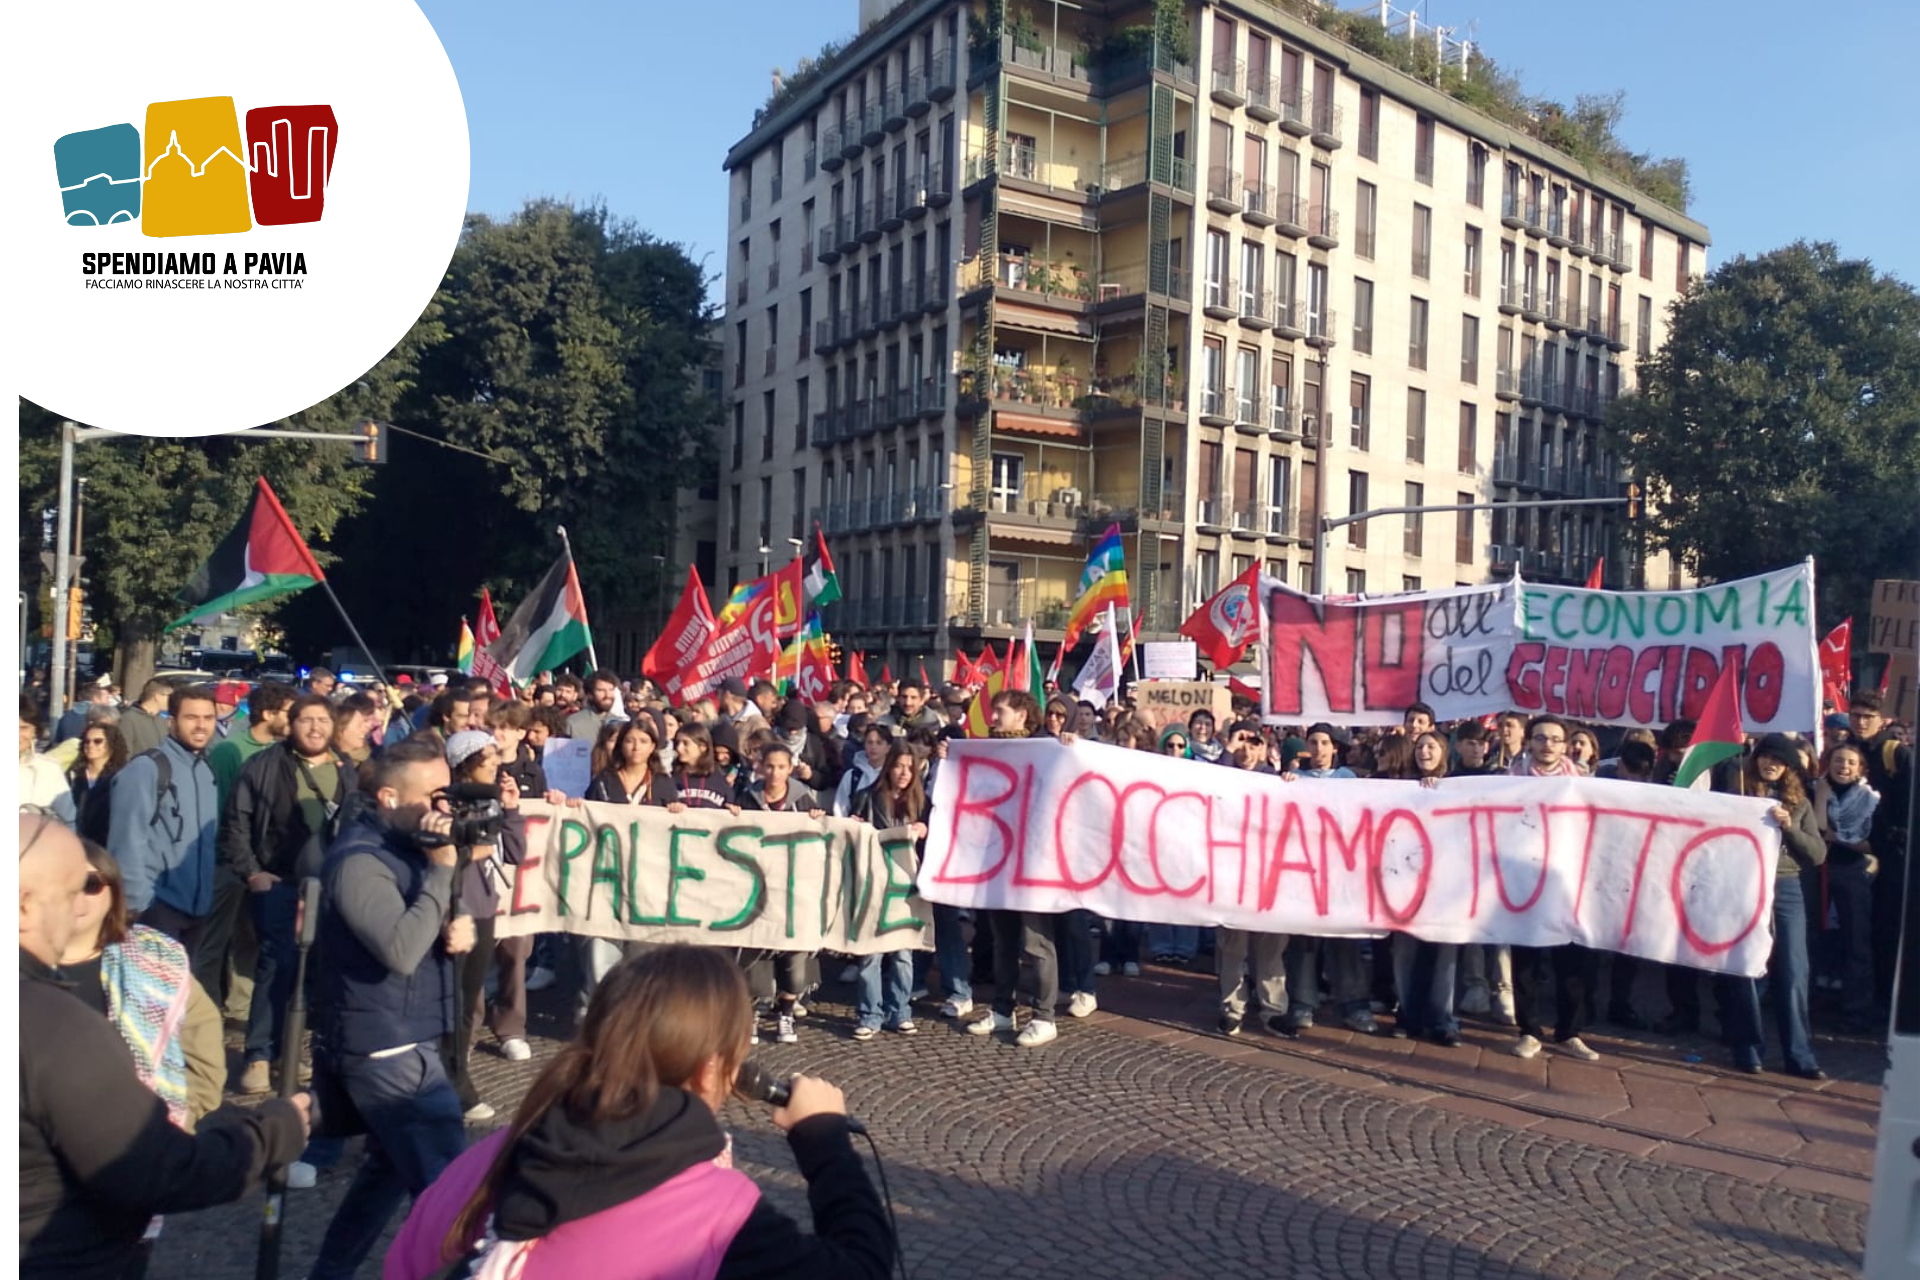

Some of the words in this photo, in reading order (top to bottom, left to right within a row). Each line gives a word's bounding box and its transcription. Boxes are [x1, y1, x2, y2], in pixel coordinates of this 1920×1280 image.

[1147, 689, 1214, 706] MELONI
[1269, 588, 1425, 715] NO
[1521, 577, 1807, 642] ECONOMIA
[1428, 646, 1492, 696] del
[1505, 640, 1785, 725] GENOCIDIO
[557, 818, 927, 942] PALESTINE
[933, 756, 1431, 926] BLOCCHIAMO
[1432, 802, 1766, 955] TUTTO
